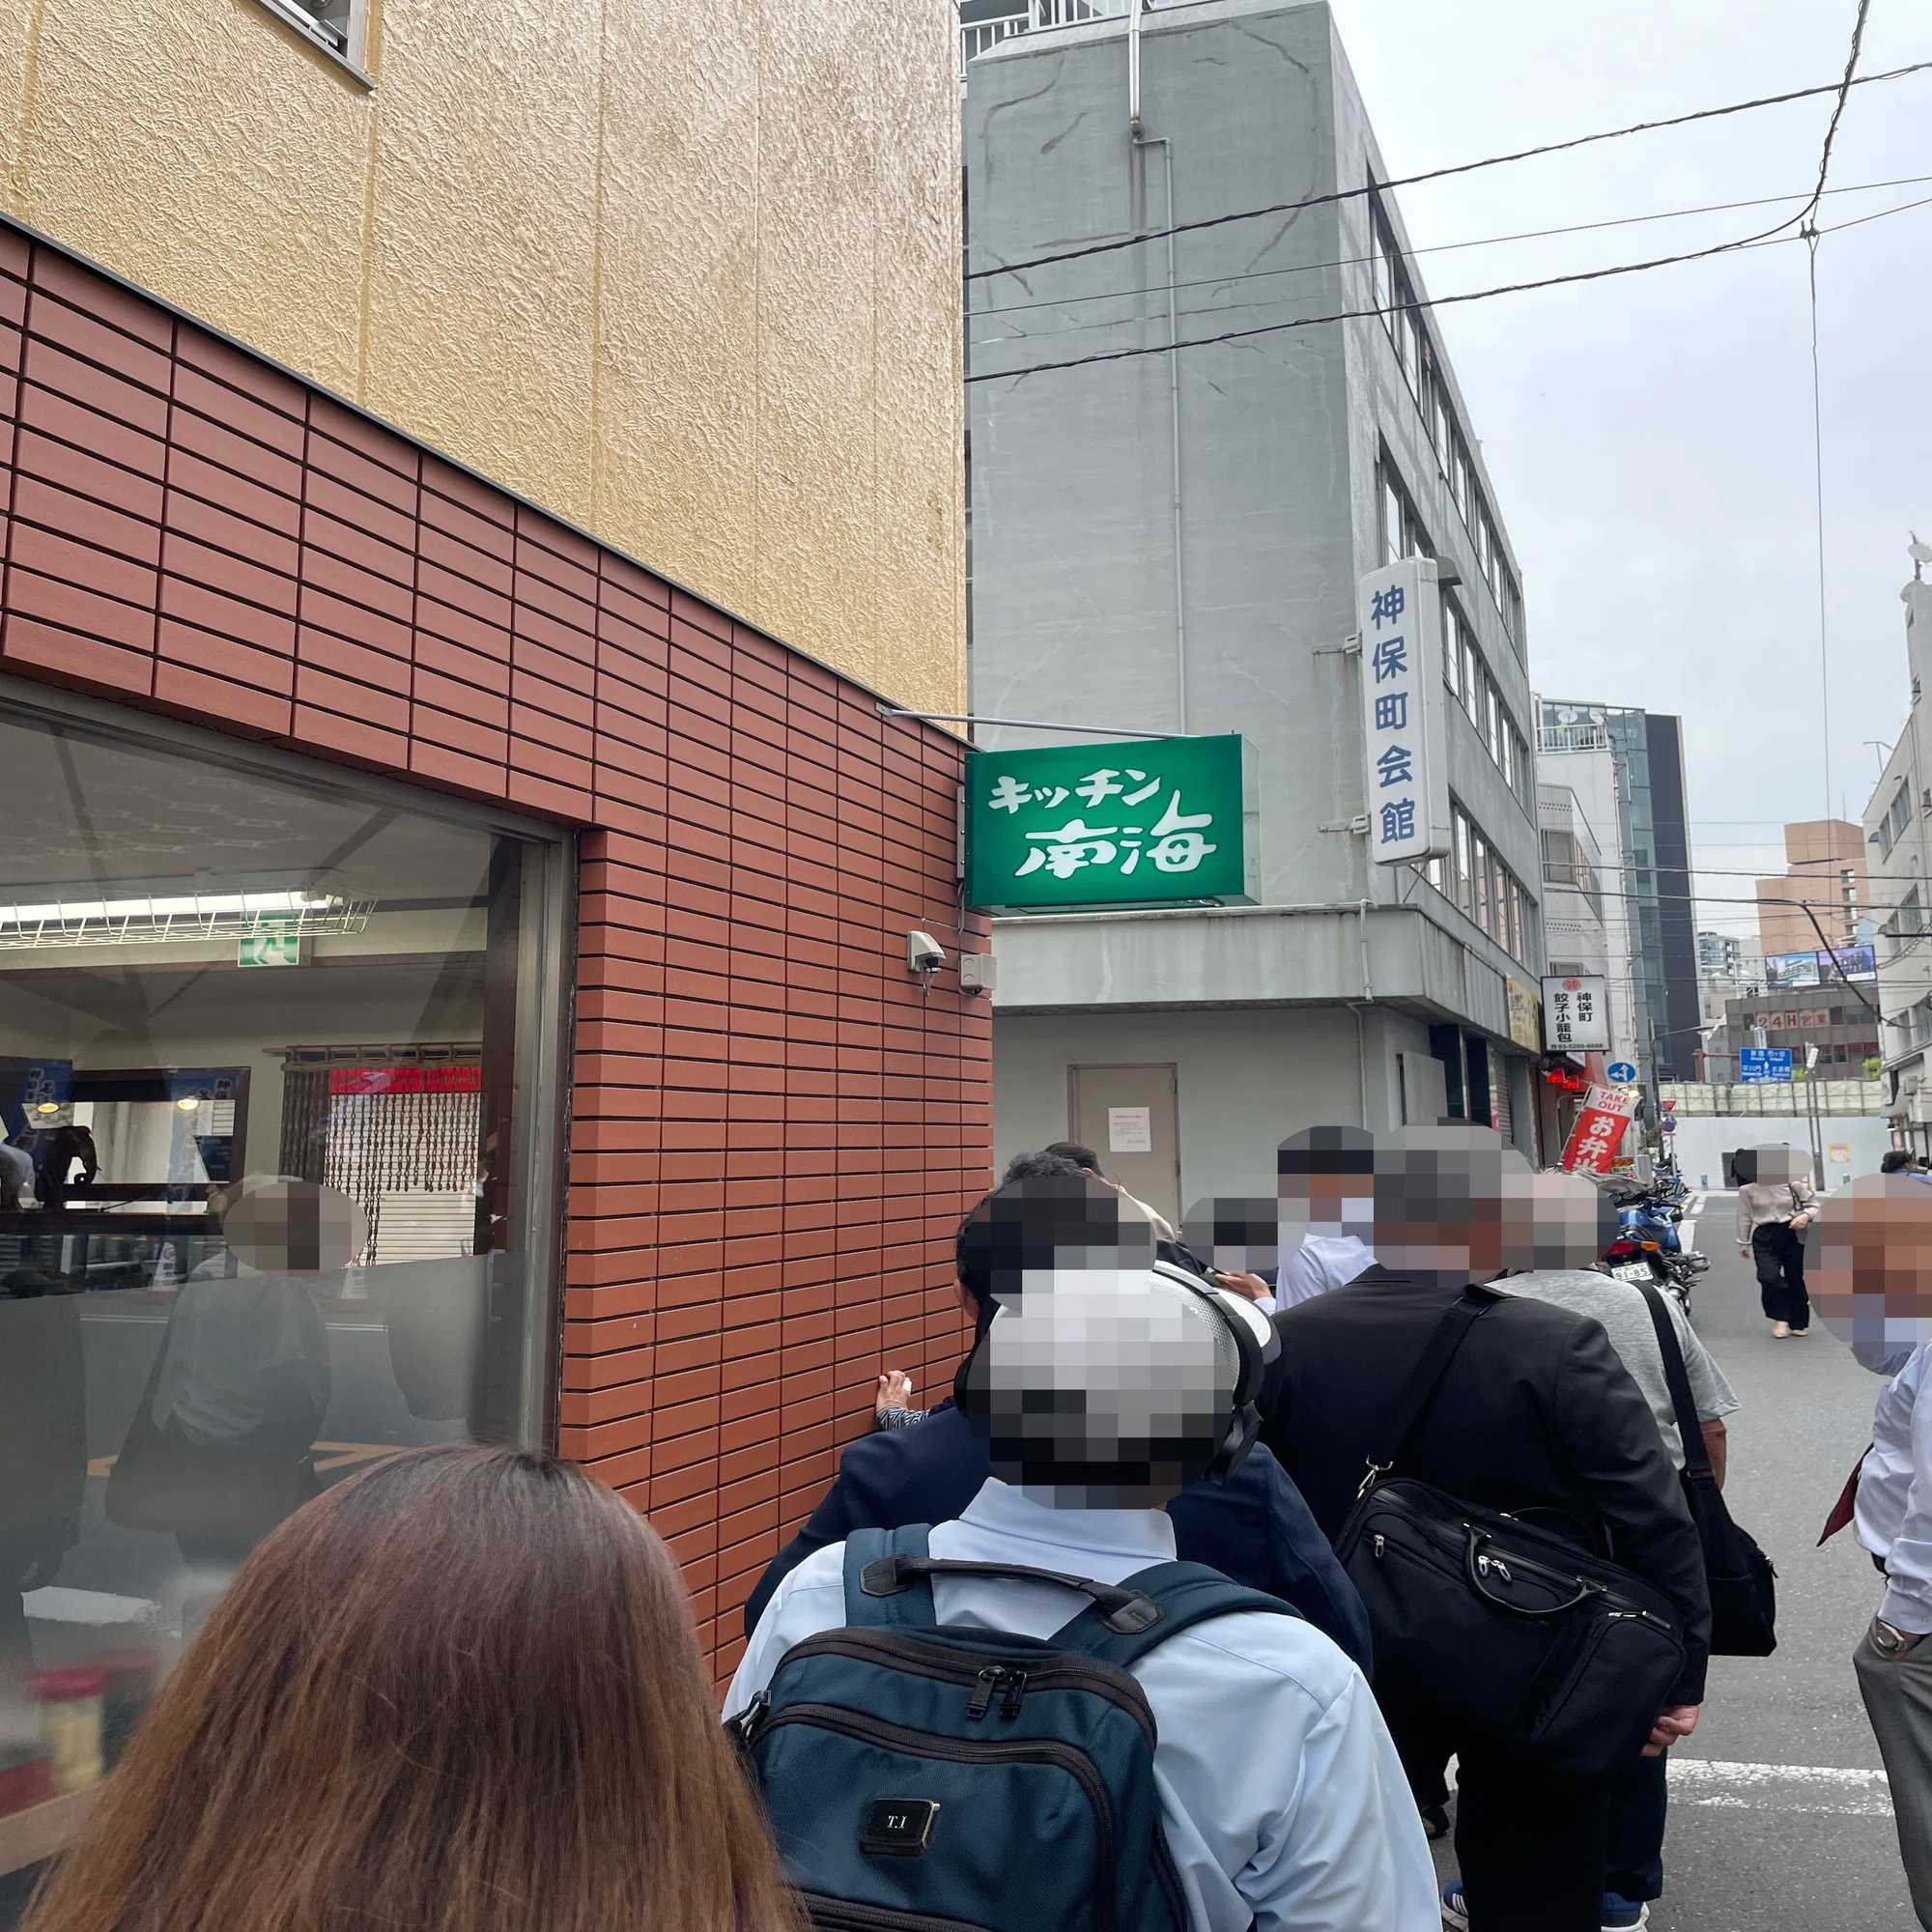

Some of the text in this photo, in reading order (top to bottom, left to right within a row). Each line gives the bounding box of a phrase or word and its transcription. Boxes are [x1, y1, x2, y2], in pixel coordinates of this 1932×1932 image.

[1371, 583, 1415, 844] 神保町会館
[988, 768, 1161, 814] キッチン
[1014, 789, 1217, 879] 南海
[1553, 992, 1573, 1042] 餃子小籠包
[1577, 992, 1593, 1022] 神保町
[1599, 1100, 1624, 1112] OUT
[1600, 1091, 1630, 1104] TAKE
[1615, 1267, 1648, 1280] 91-85
